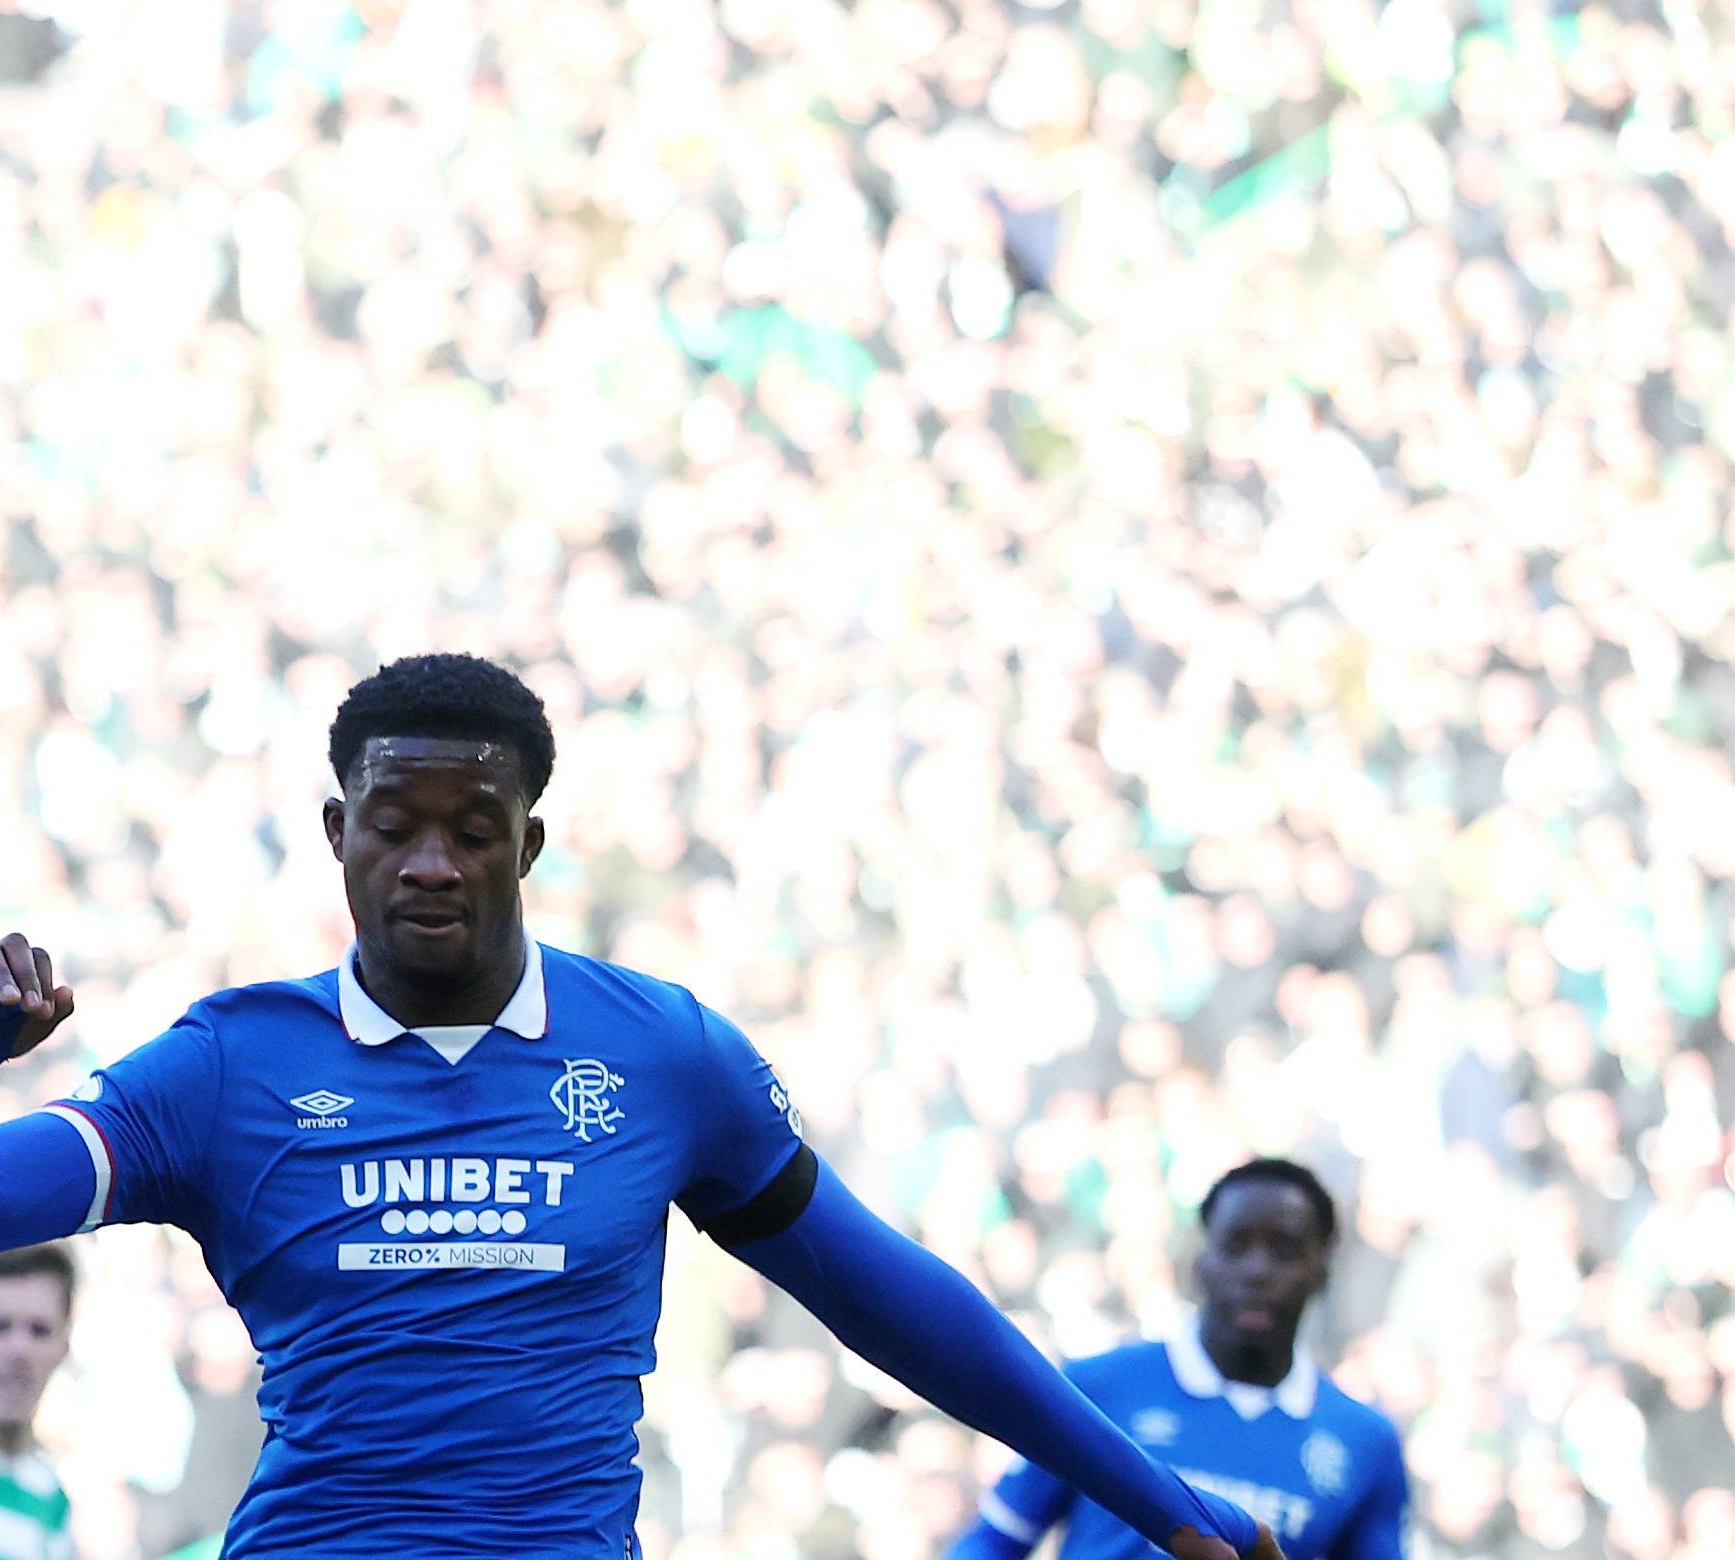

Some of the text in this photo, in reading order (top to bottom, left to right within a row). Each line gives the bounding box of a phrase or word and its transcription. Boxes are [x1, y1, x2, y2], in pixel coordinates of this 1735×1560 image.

[297, 1116, 348, 1129] umbro
[340, 1158, 574, 1208] UNIBET
[369, 1248, 534, 1265] ZERO% MISSION
